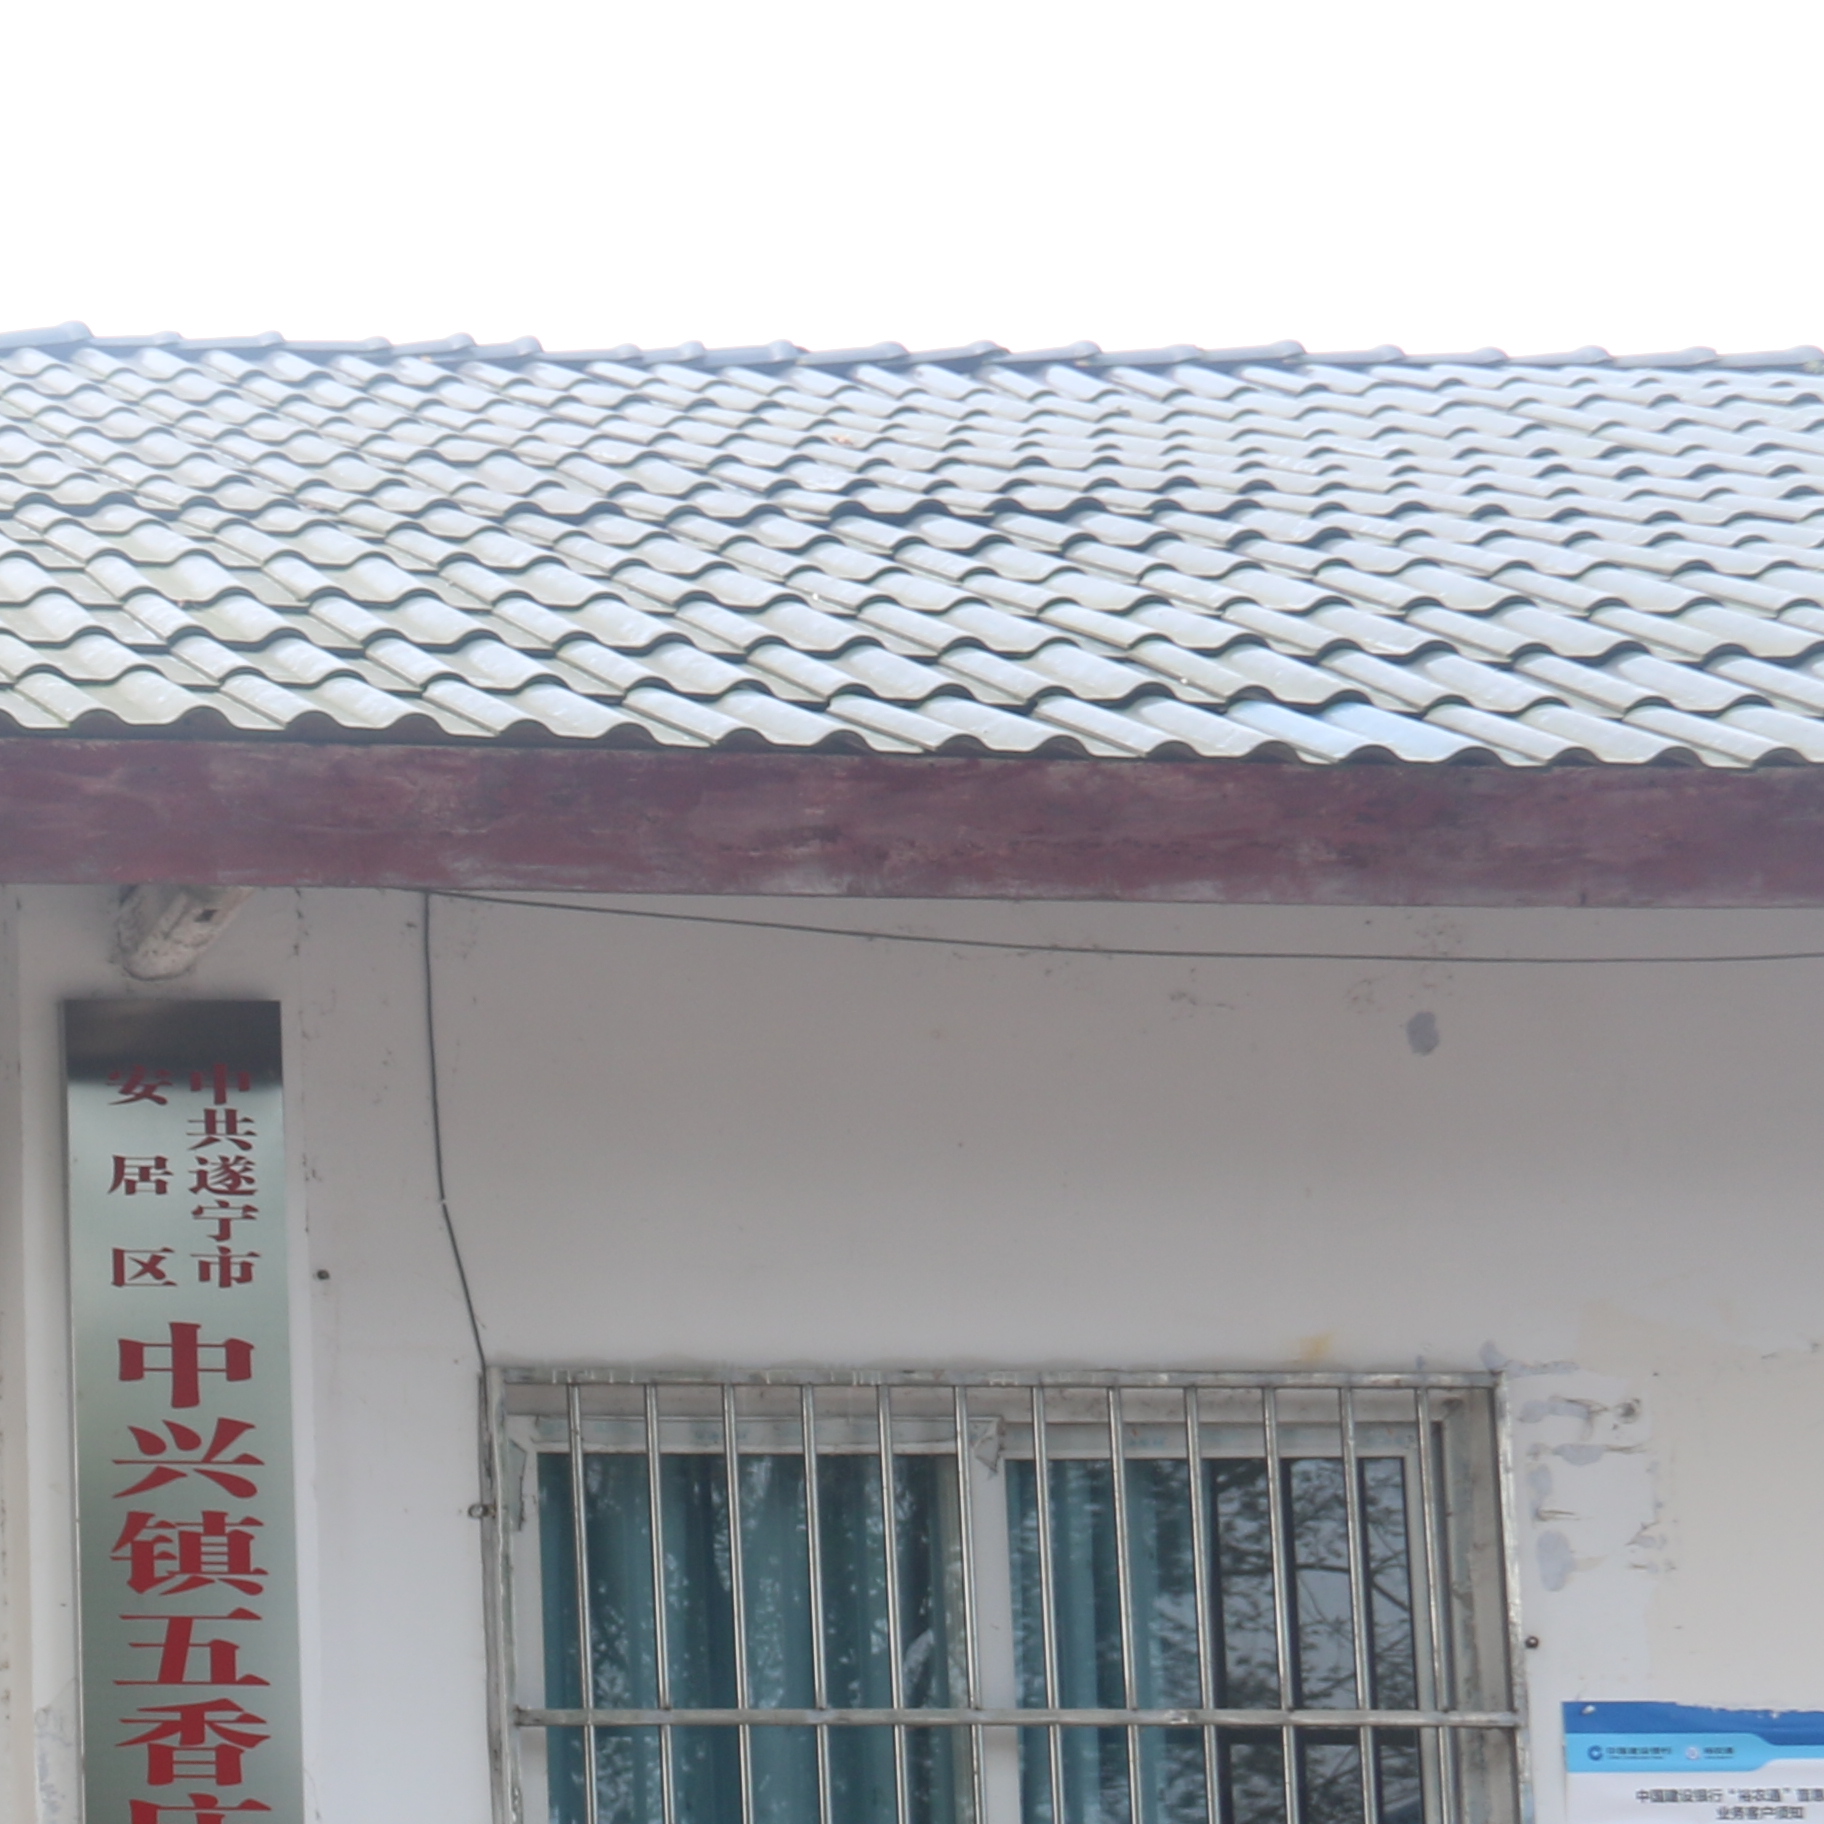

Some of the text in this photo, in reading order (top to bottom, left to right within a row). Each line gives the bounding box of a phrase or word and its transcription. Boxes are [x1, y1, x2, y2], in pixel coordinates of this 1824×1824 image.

[105, 1063, 178, 1288] 安居区
[186, 1062, 261, 1288] 中共遂宁市
